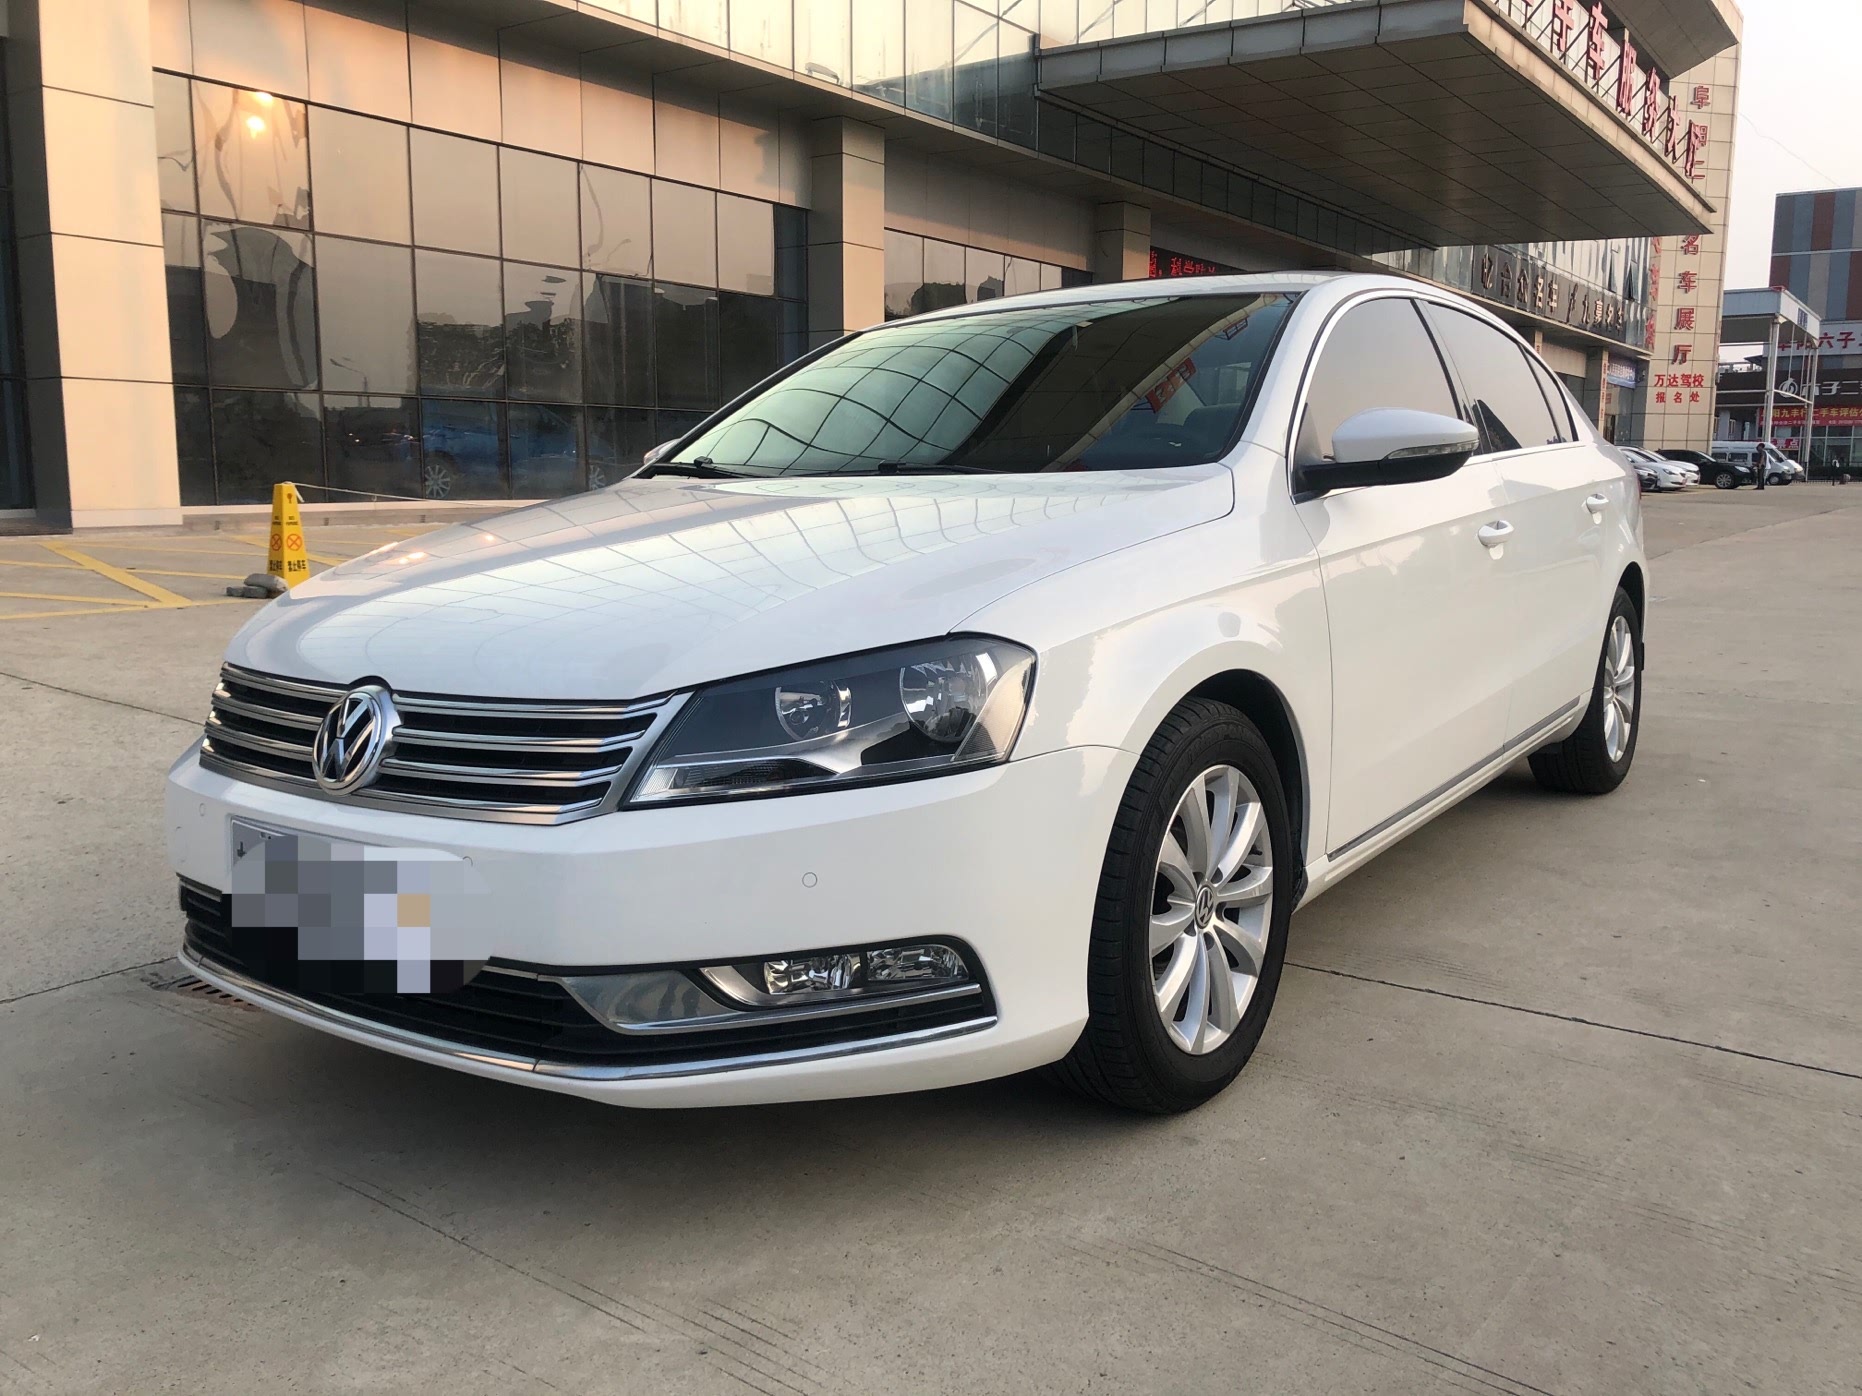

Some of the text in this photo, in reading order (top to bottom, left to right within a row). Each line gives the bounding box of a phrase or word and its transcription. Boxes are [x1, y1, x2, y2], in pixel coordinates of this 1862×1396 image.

[1518, 0, 1701, 178] 手车服务大厅
[1653, 373, 1705, 388] 万达驾校
[1801, 379, 1862, 396] 六子二
[1655, 391, 1701, 404] 报名处
